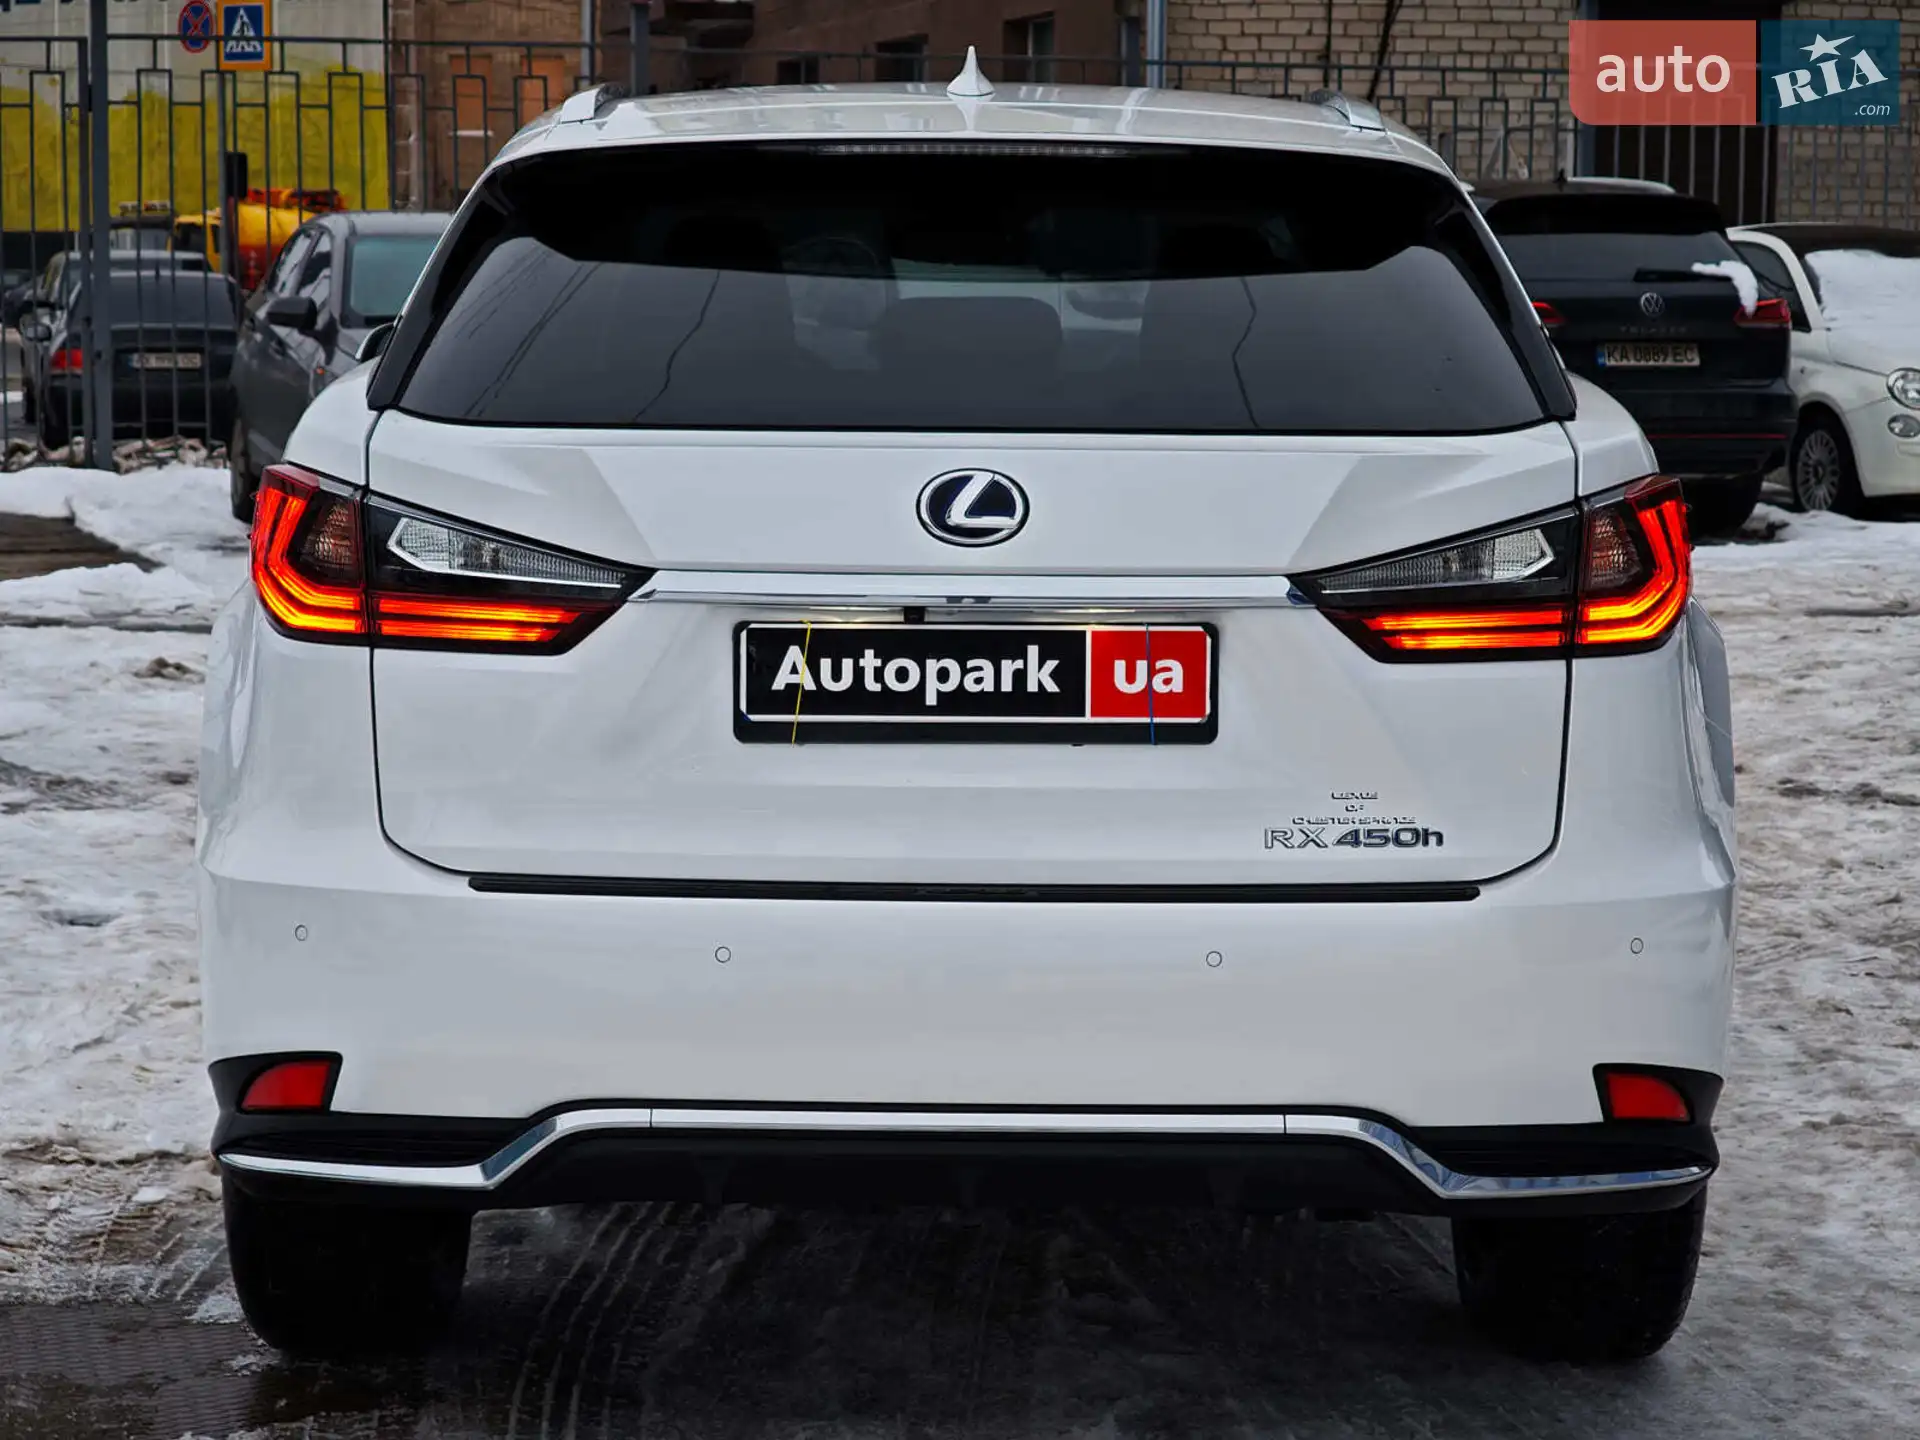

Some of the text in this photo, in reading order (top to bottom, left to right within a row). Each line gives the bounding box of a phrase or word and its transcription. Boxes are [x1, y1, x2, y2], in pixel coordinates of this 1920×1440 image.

[771, 644, 1184, 706] Autopark ua
[1264, 827, 1444, 849] RX 450h
